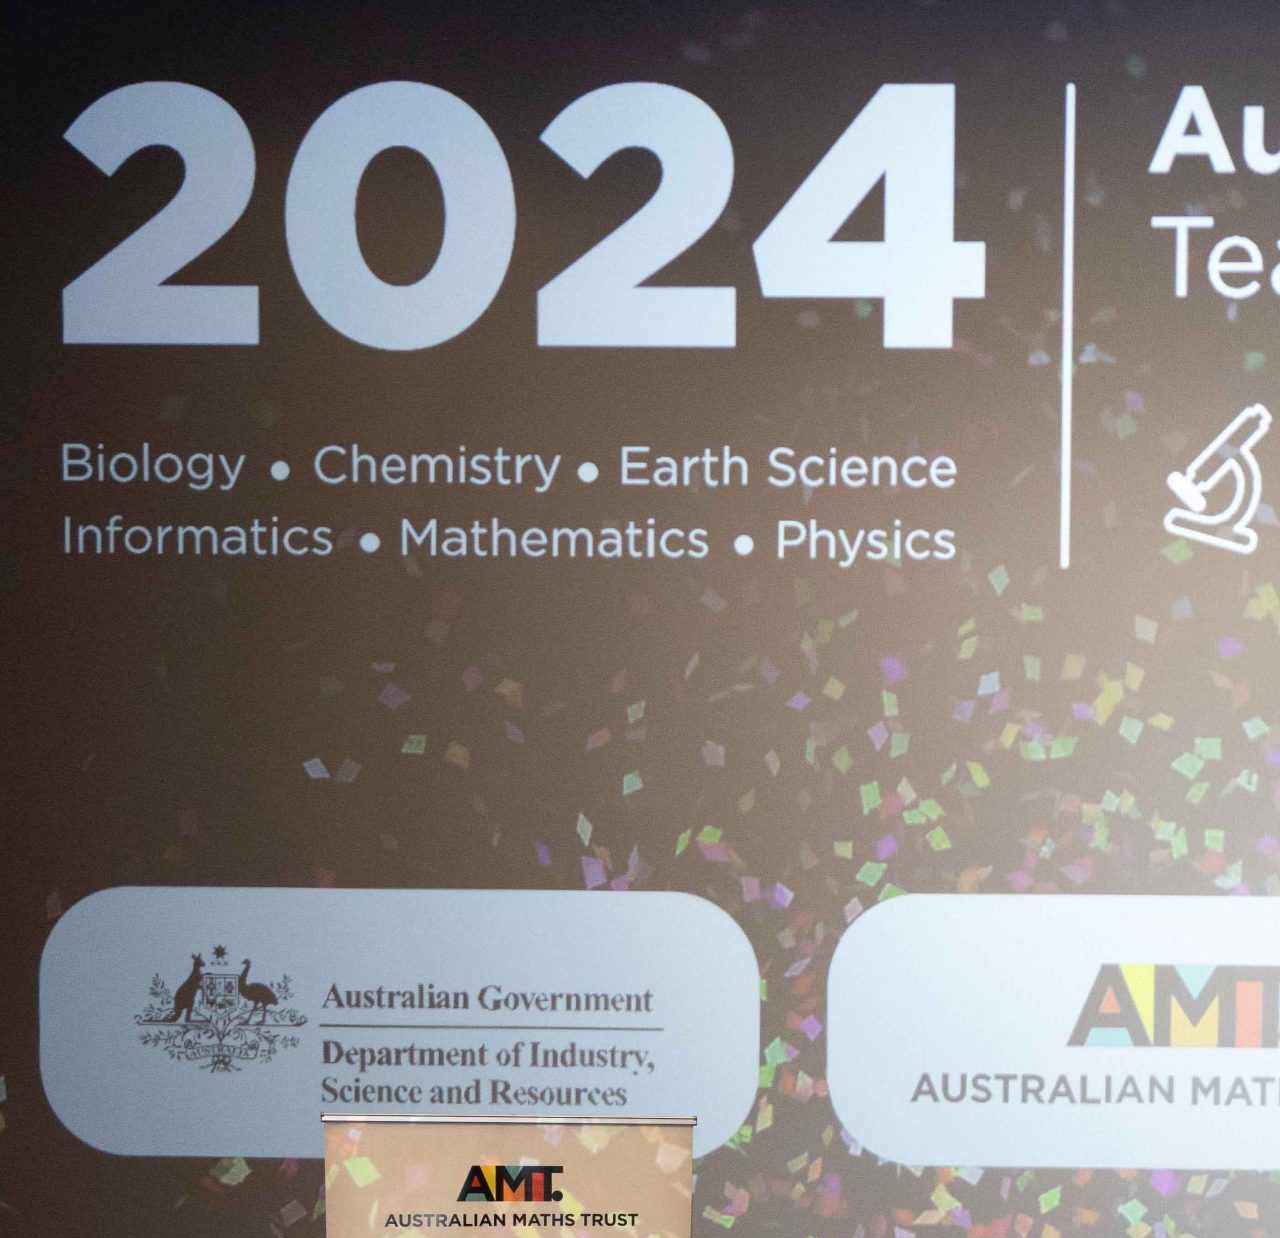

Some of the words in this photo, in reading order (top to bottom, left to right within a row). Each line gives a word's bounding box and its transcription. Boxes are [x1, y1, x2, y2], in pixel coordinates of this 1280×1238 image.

[64, 81, 986, 353] 2024
[63, 443, 245, 490] Biology
[315, 445, 561, 492] Chemistry
[622, 446, 748, 486] Earth
[769, 448, 957, 488] Science
[65, 516, 333, 555] Informatics
[402, 518, 709, 558] Mathematics
[778, 520, 955, 567] Physics
[321, 983, 470, 1010] Australian
[477, 984, 654, 1012] Government
[323, 1040, 485, 1073] Department
[496, 1042, 525, 1067] of
[530, 1042, 654, 1075] Industry,
[321, 1077, 422, 1103] Science
[430, 1079, 481, 1104] and
[490, 1079, 627, 1105] Resources
[910, 1073, 1173, 1104] AUSTRALIAN
[385, 1214, 505, 1227] AUSTRALIAN
[513, 1214, 575, 1226] MATHS
[582, 1213, 638, 1226] TRUST
